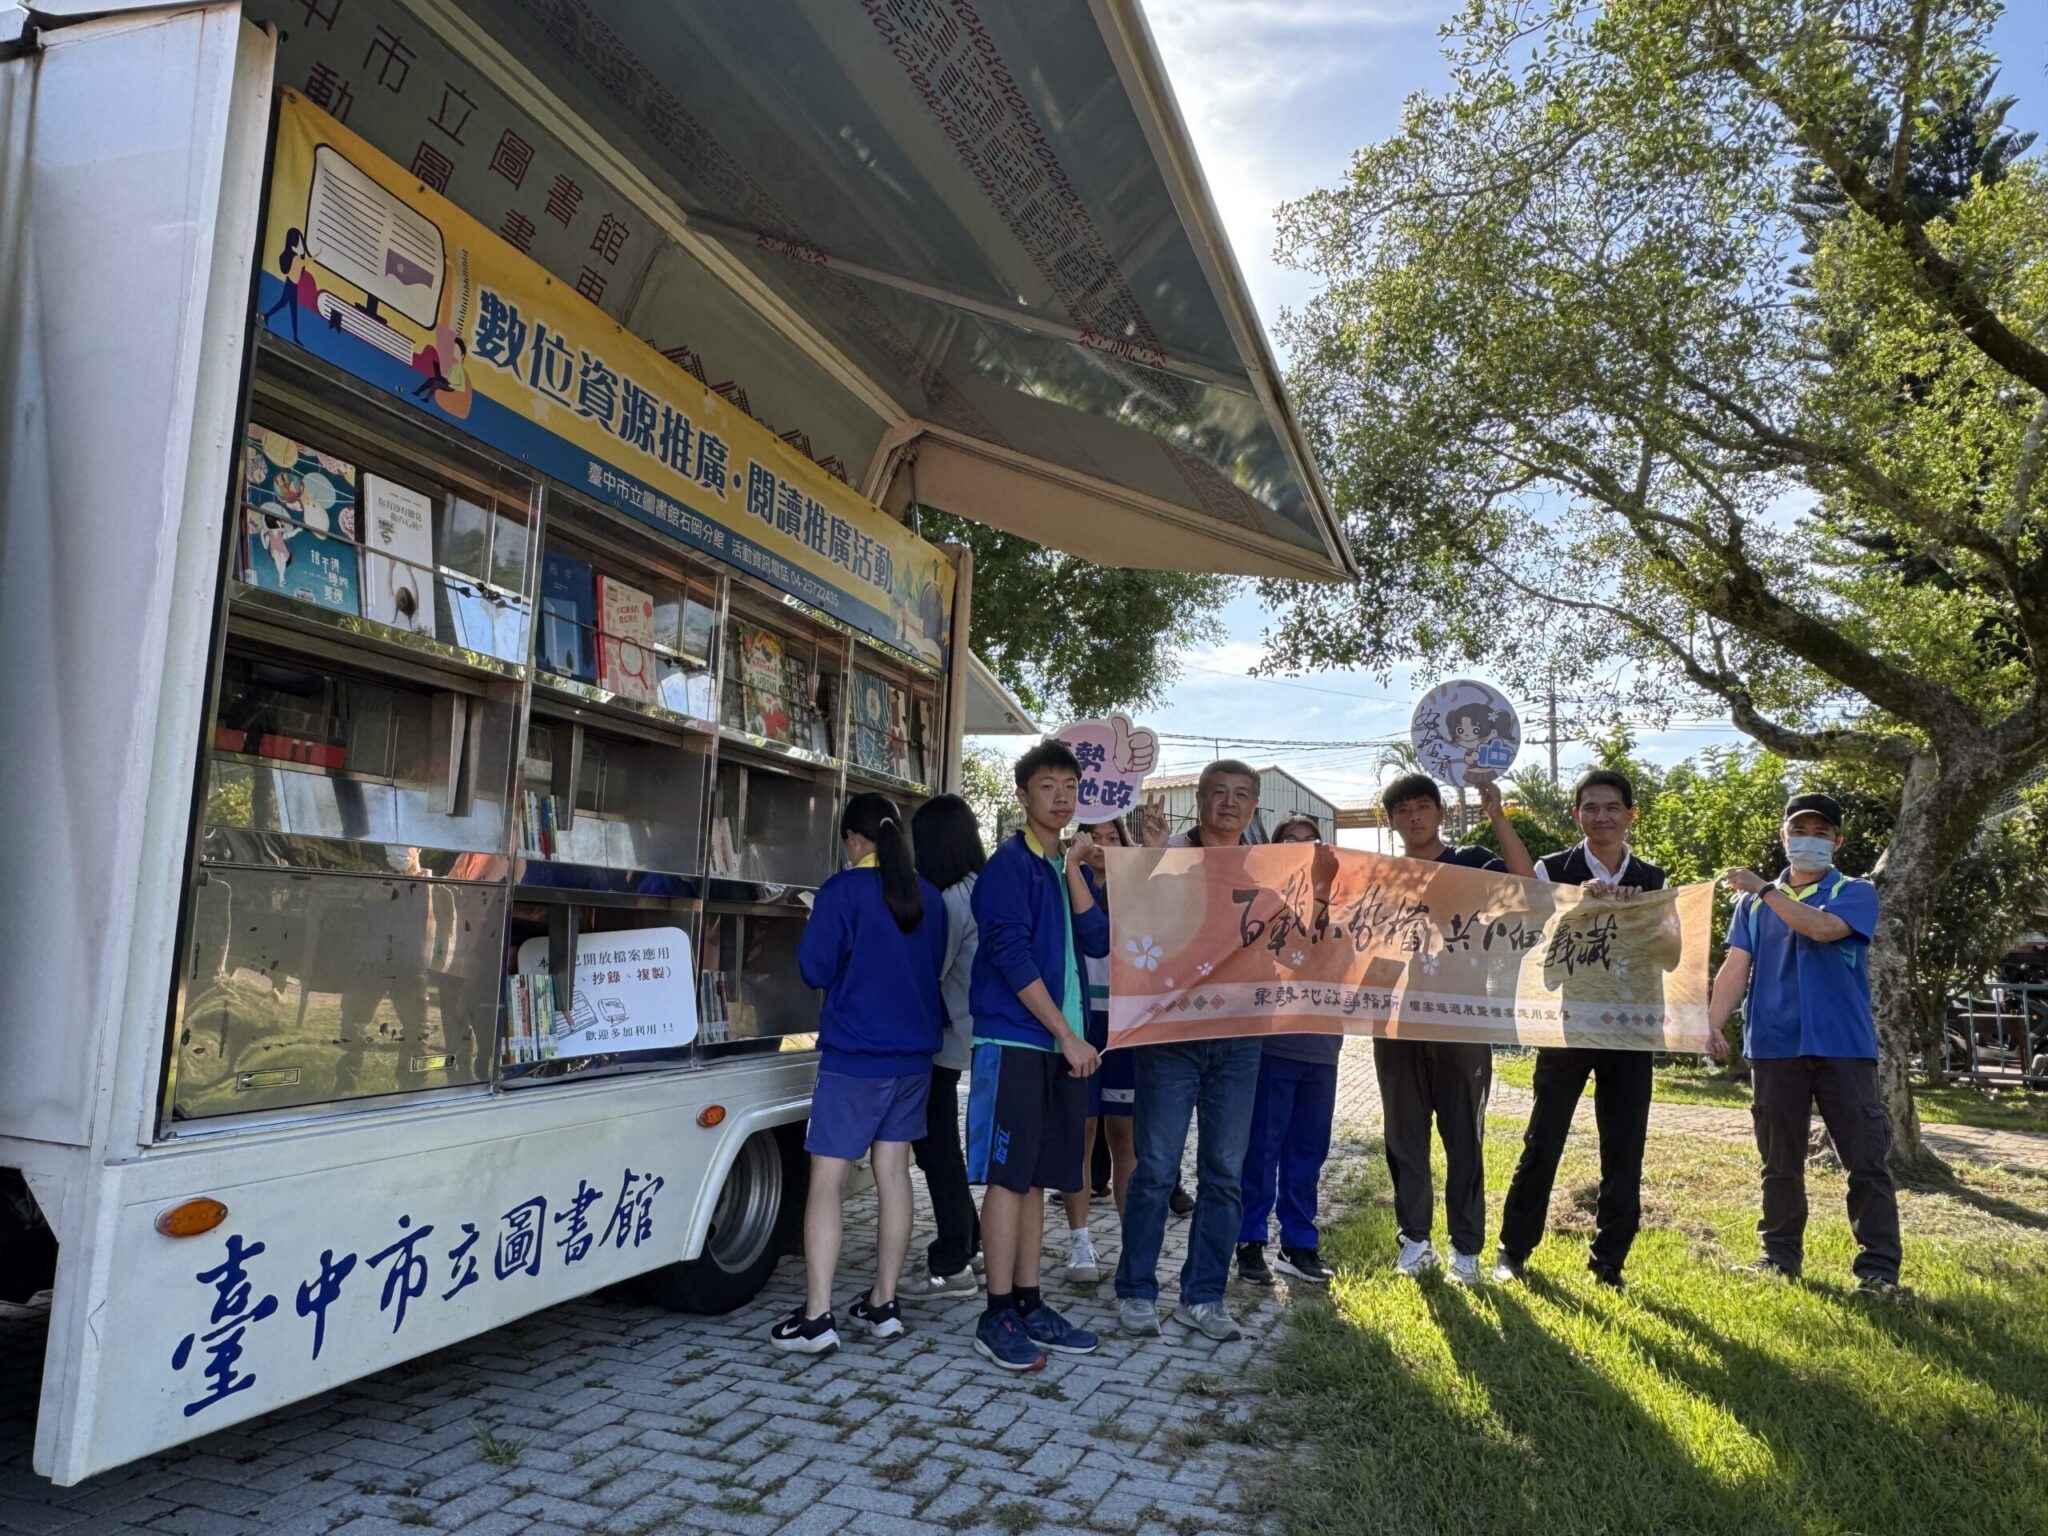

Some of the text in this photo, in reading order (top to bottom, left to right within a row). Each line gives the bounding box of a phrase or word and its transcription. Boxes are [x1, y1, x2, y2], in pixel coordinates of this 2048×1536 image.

[588, 460, 725, 550] 臺中市立圖書館石岡分館
[1254, 986, 1400, 1014] 東勢地政事務所
[171, 1167, 667, 1418] 臺中市立圖書館
